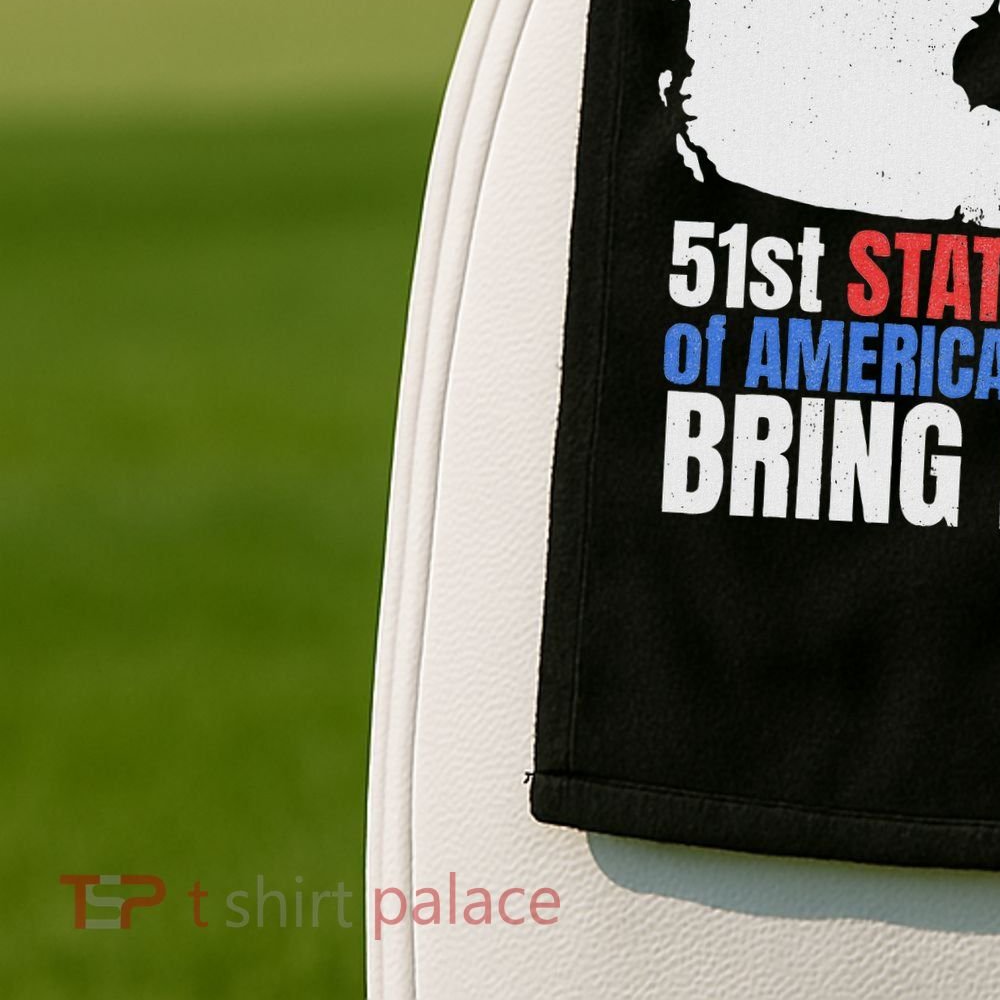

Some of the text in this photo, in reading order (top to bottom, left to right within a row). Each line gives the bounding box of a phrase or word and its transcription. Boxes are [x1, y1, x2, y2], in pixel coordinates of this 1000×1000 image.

[669, 220, 825, 312] 51st
[663, 315, 726, 386] of
[661, 391, 963, 527] BRING
